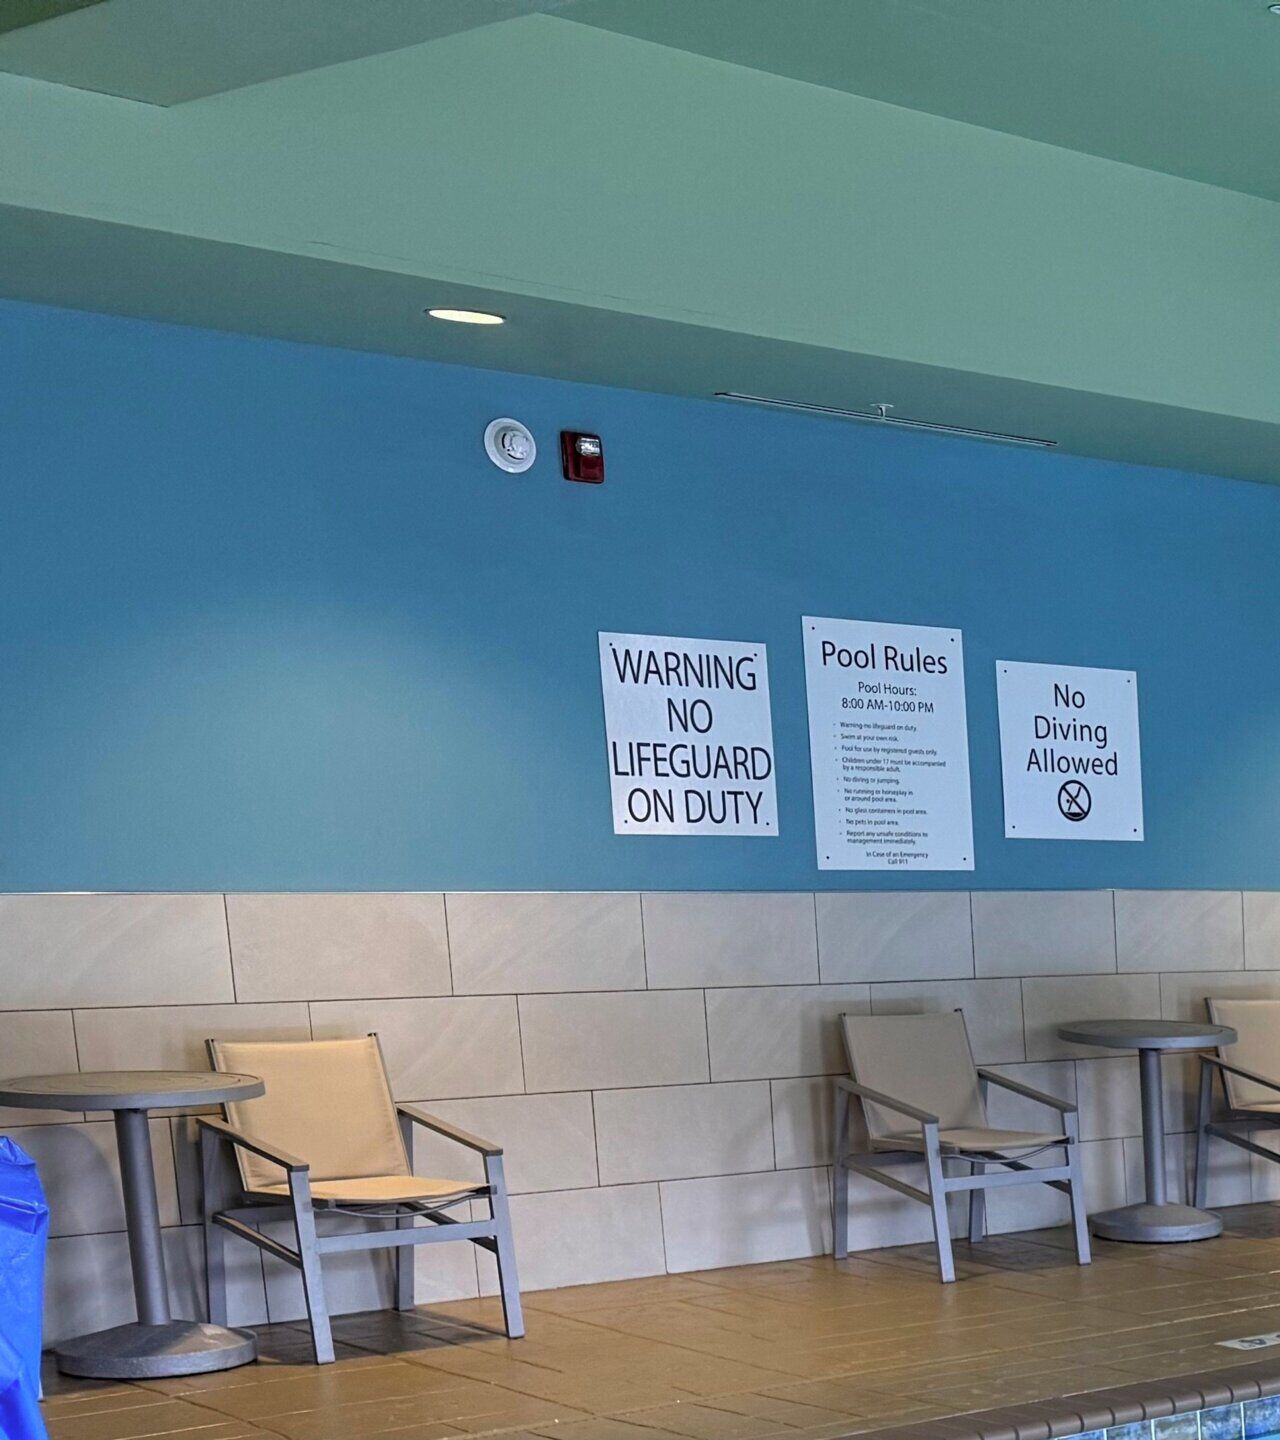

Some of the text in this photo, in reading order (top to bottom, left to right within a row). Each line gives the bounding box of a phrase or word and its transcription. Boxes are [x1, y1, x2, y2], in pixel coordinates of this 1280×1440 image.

[612, 648, 757, 691] WARNING
[821, 640, 948, 674] Pool Rules
[841, 697, 934, 713] 8:00 AM-10:00 PM
[858, 681, 917, 696] Pool Hours:
[1054, 683, 1085, 708] No
[668, 698, 713, 733] NO
[1034, 715, 1107, 749] Diving
[612, 741, 772, 780] LIFEGUARD
[873, 746, 880, 754] by
[1027, 748, 1117, 776] Allowed
[628, 788, 763, 824] ON DUTY
